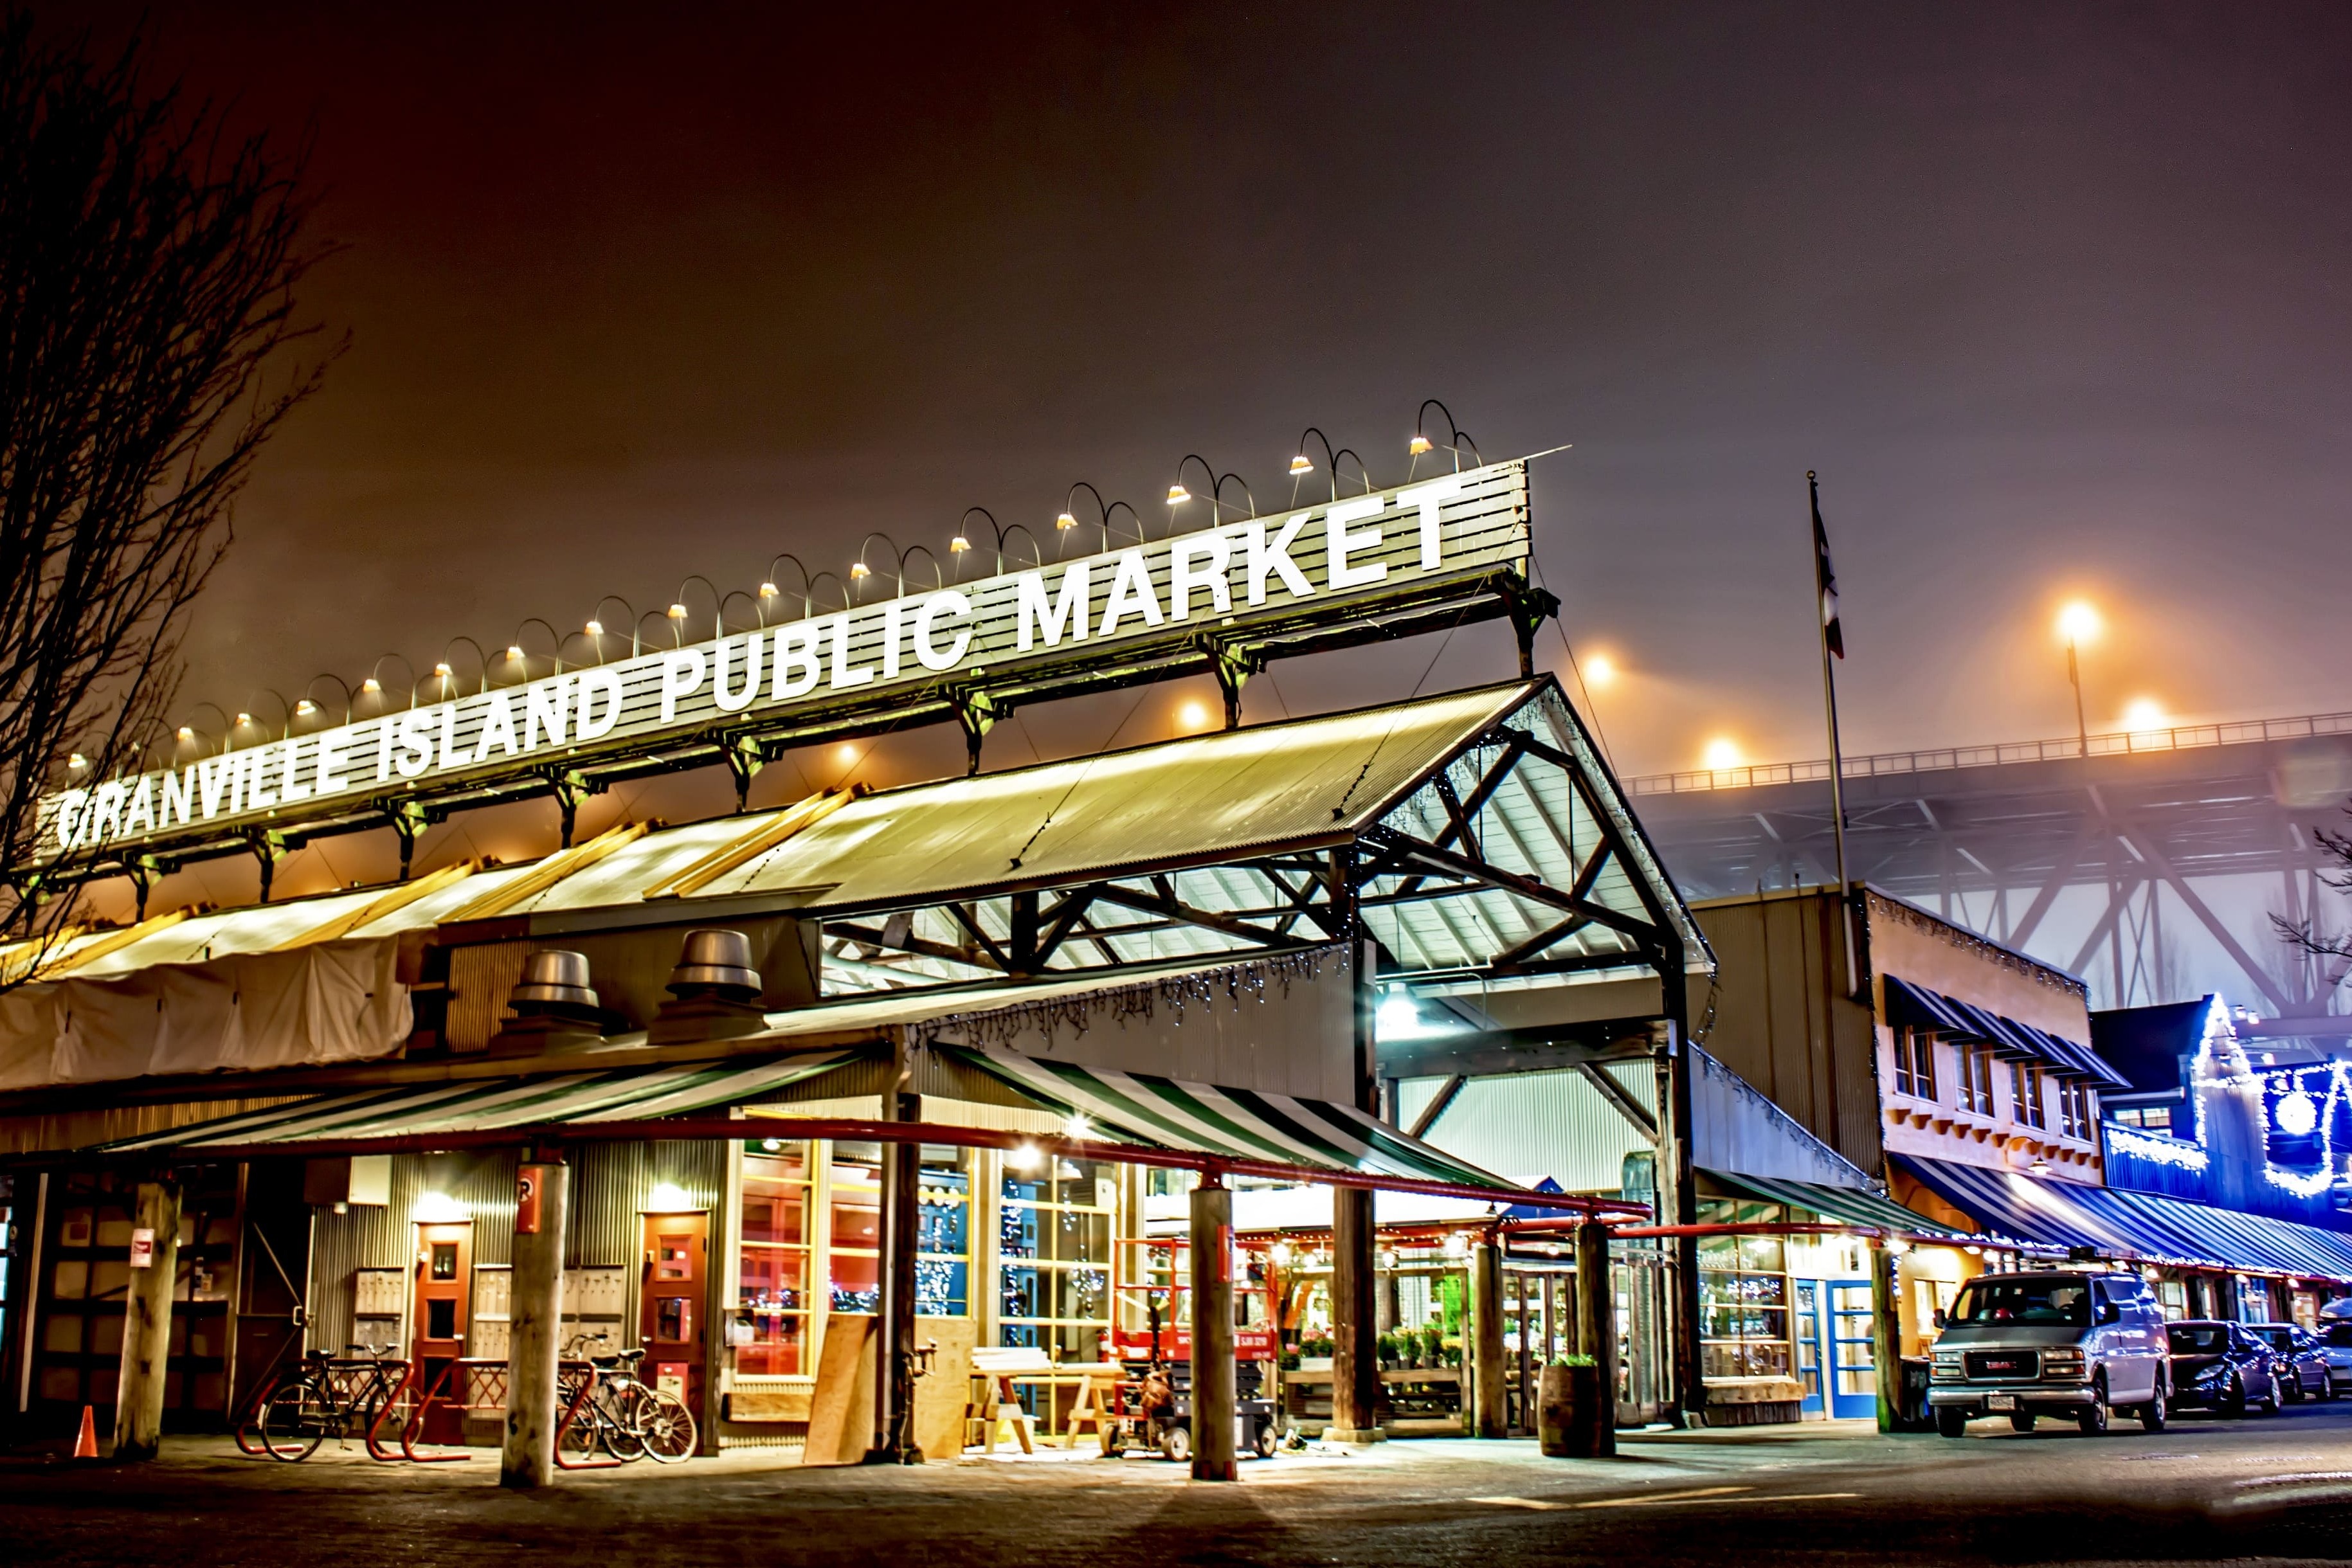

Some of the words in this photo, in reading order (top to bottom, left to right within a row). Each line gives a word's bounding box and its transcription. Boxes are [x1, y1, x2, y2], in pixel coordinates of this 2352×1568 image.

[57, 725, 353, 848] GRANVILLE
[377, 667, 623, 782] ISLAND
[660, 590, 972, 724] PUBLIC
[1017, 478, 1462, 653] MARKET
